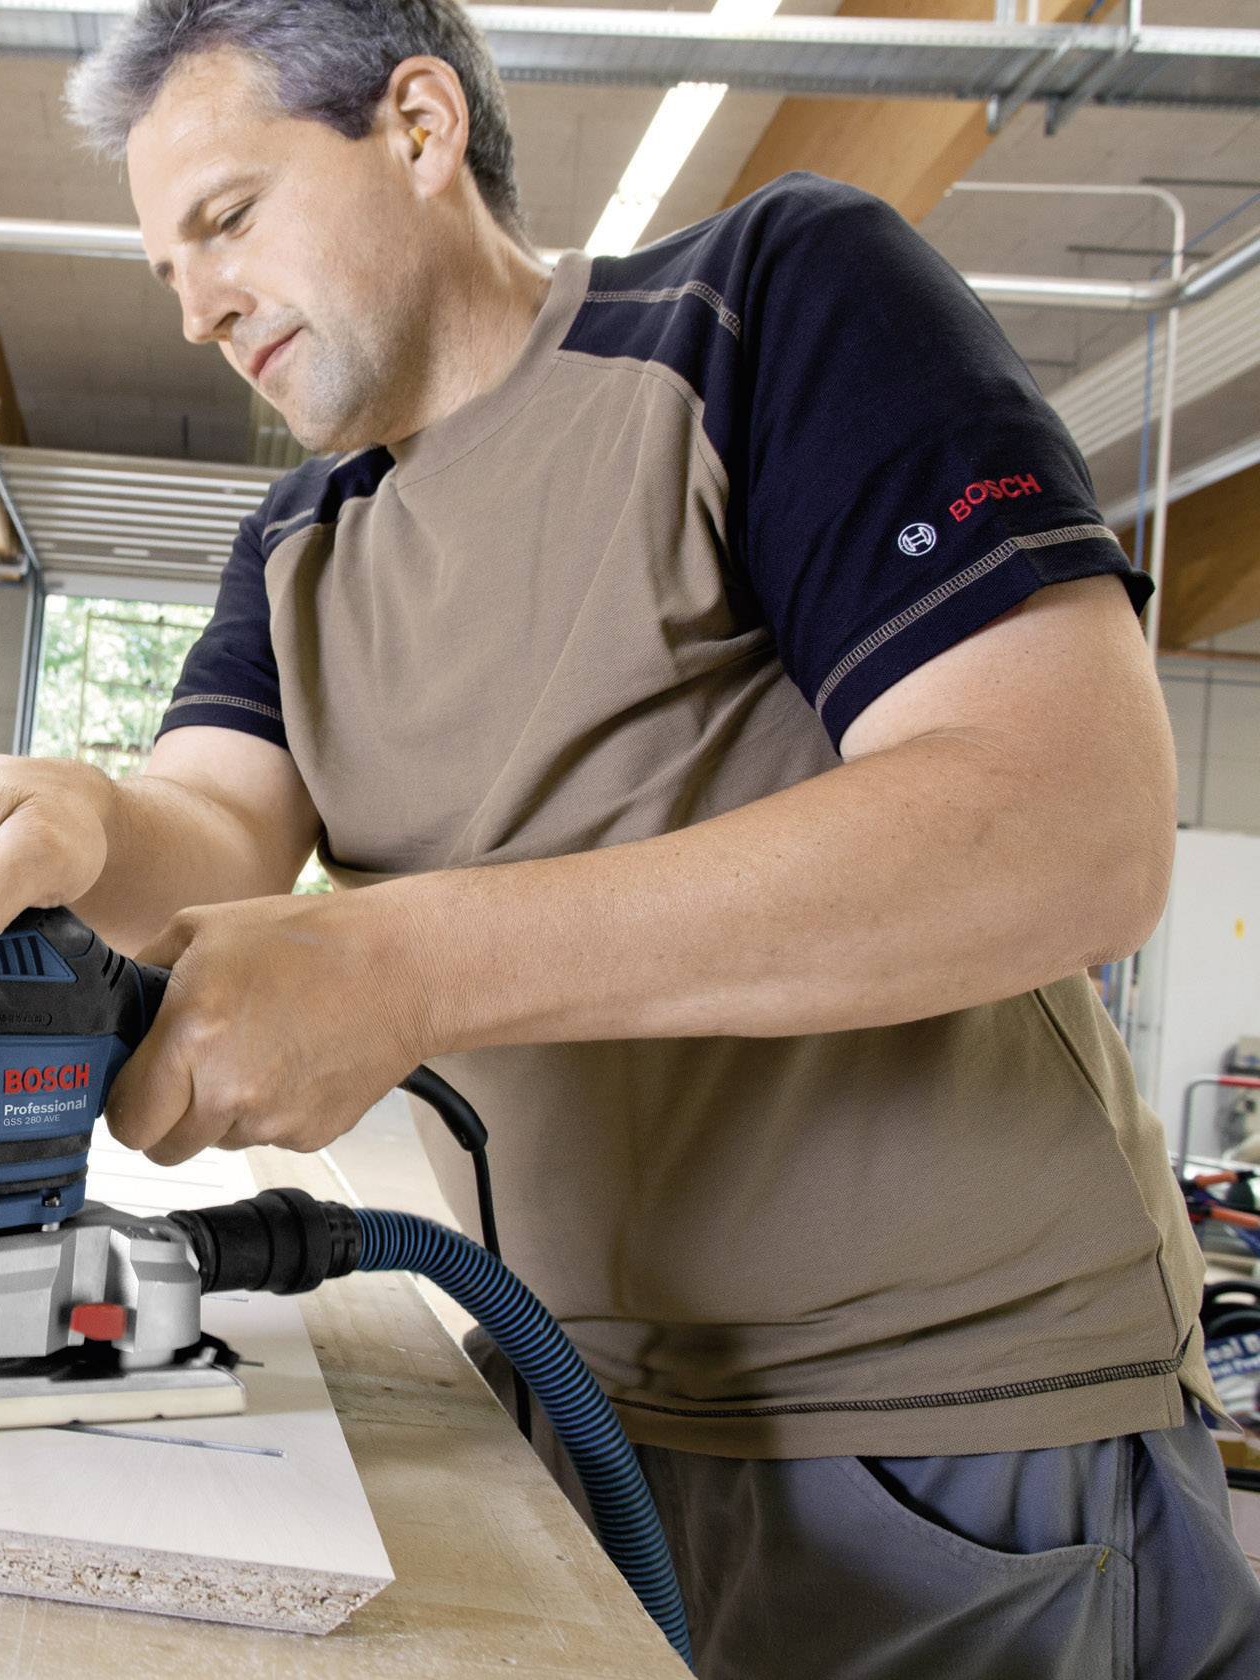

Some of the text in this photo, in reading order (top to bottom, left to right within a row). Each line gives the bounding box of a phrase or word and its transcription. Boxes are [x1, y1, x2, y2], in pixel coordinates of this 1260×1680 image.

[948, 474, 1043, 522] BOSCH
[3, 1062, 90, 1094] BOSCH
[3, 1094, 87, 1116] Professional
[3, 1113, 61, 1127] GSS 280 AVE
